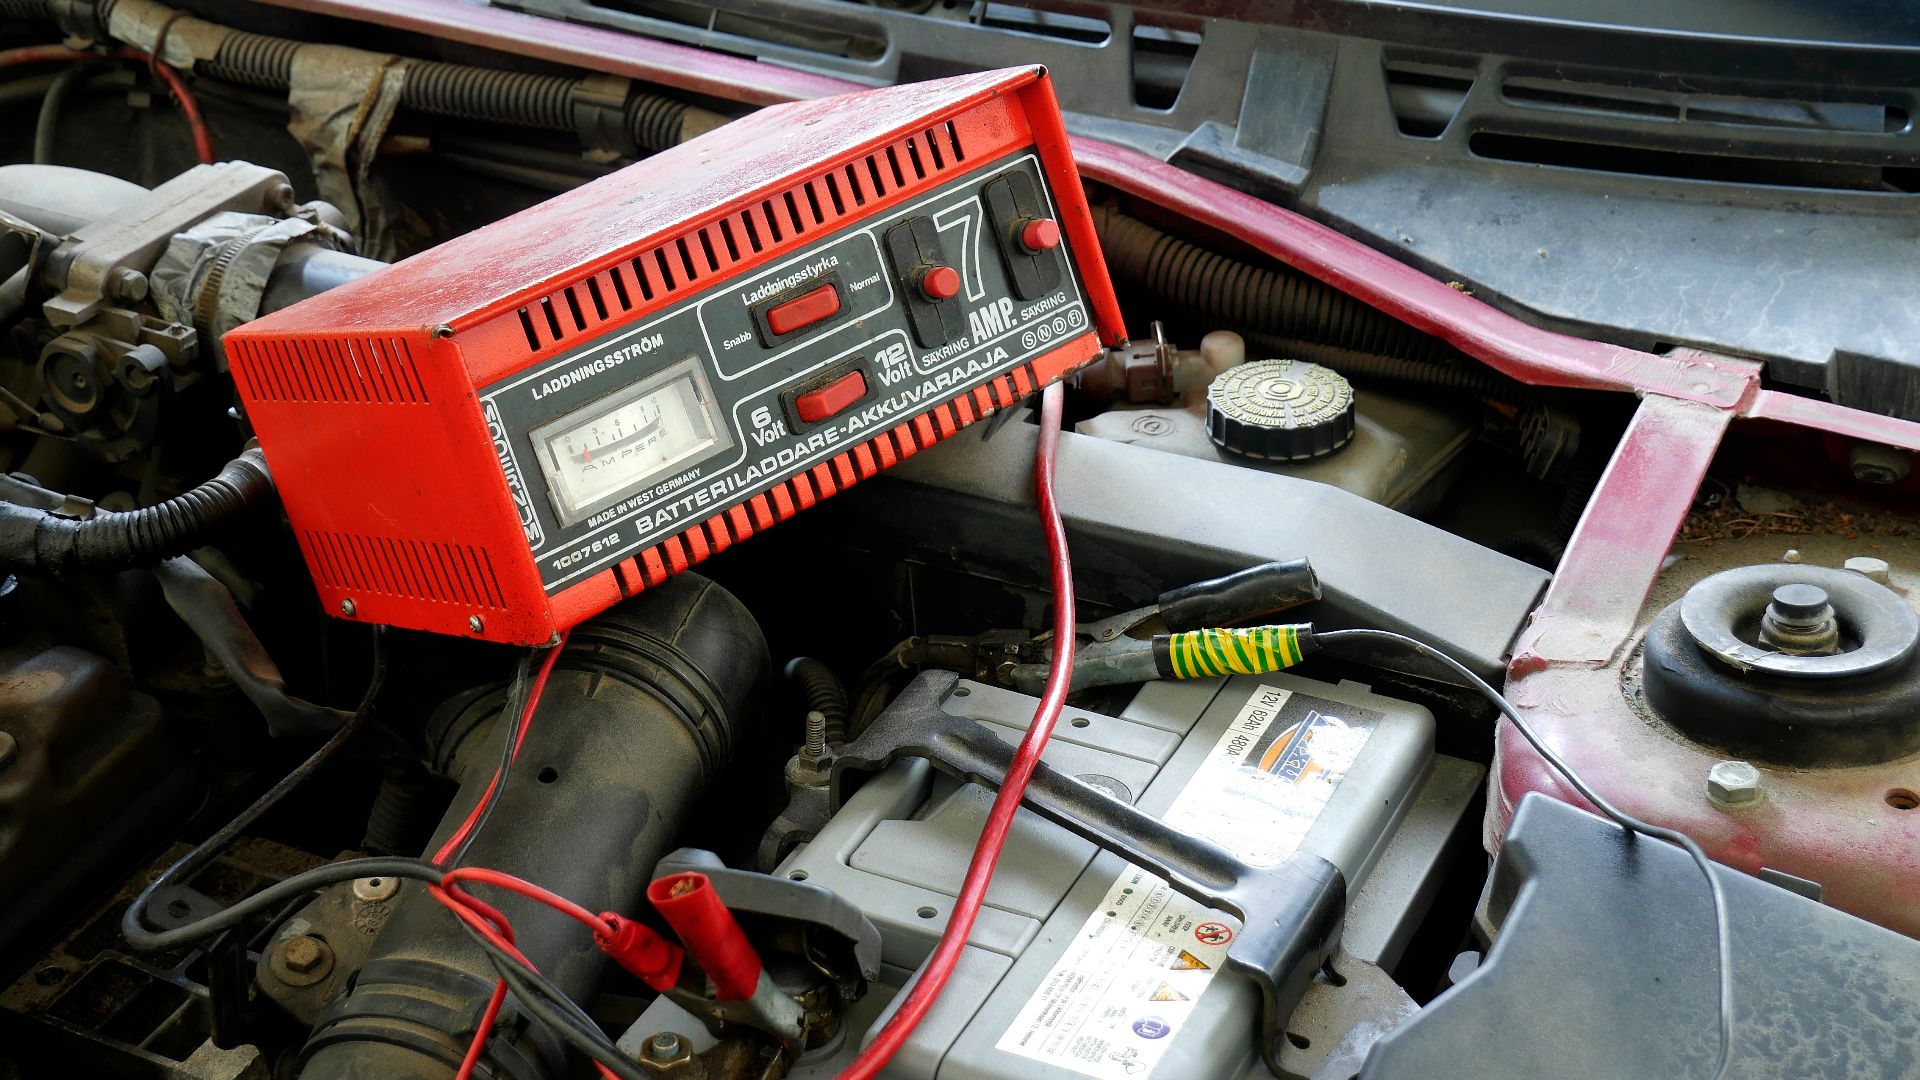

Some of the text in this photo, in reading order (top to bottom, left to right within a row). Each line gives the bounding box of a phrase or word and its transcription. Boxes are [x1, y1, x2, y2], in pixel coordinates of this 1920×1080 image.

[932, 195, 985, 302] 7
[741, 254, 839, 306] Laddningsstyrka
[849, 272, 880, 292] Normal
[969, 296, 1018, 345] AMP.
[1020, 291, 1066, 321] SÄKRING
[723, 331, 752, 350] Snabb
[874, 342, 907, 369] 12
[921, 337, 970, 368] SÄKRING
[531, 333, 664, 401] LADDNINGSSTRÖM
[878, 362, 914, 387] Volt
[751, 405, 772, 429] 6
[635, 347, 1009, 535] BATTERILADDARE-AKKUVARAAJA
[751, 420, 787, 447] Volt
[582, 428, 667, 473] AMPERE
[587, 468, 701, 528] MADE IN WEST GERMANY
[553, 532, 621, 570] 1007612
[1263, 691, 1281, 708] 12V
[1242, 709, 1268, 731] 62Ah
